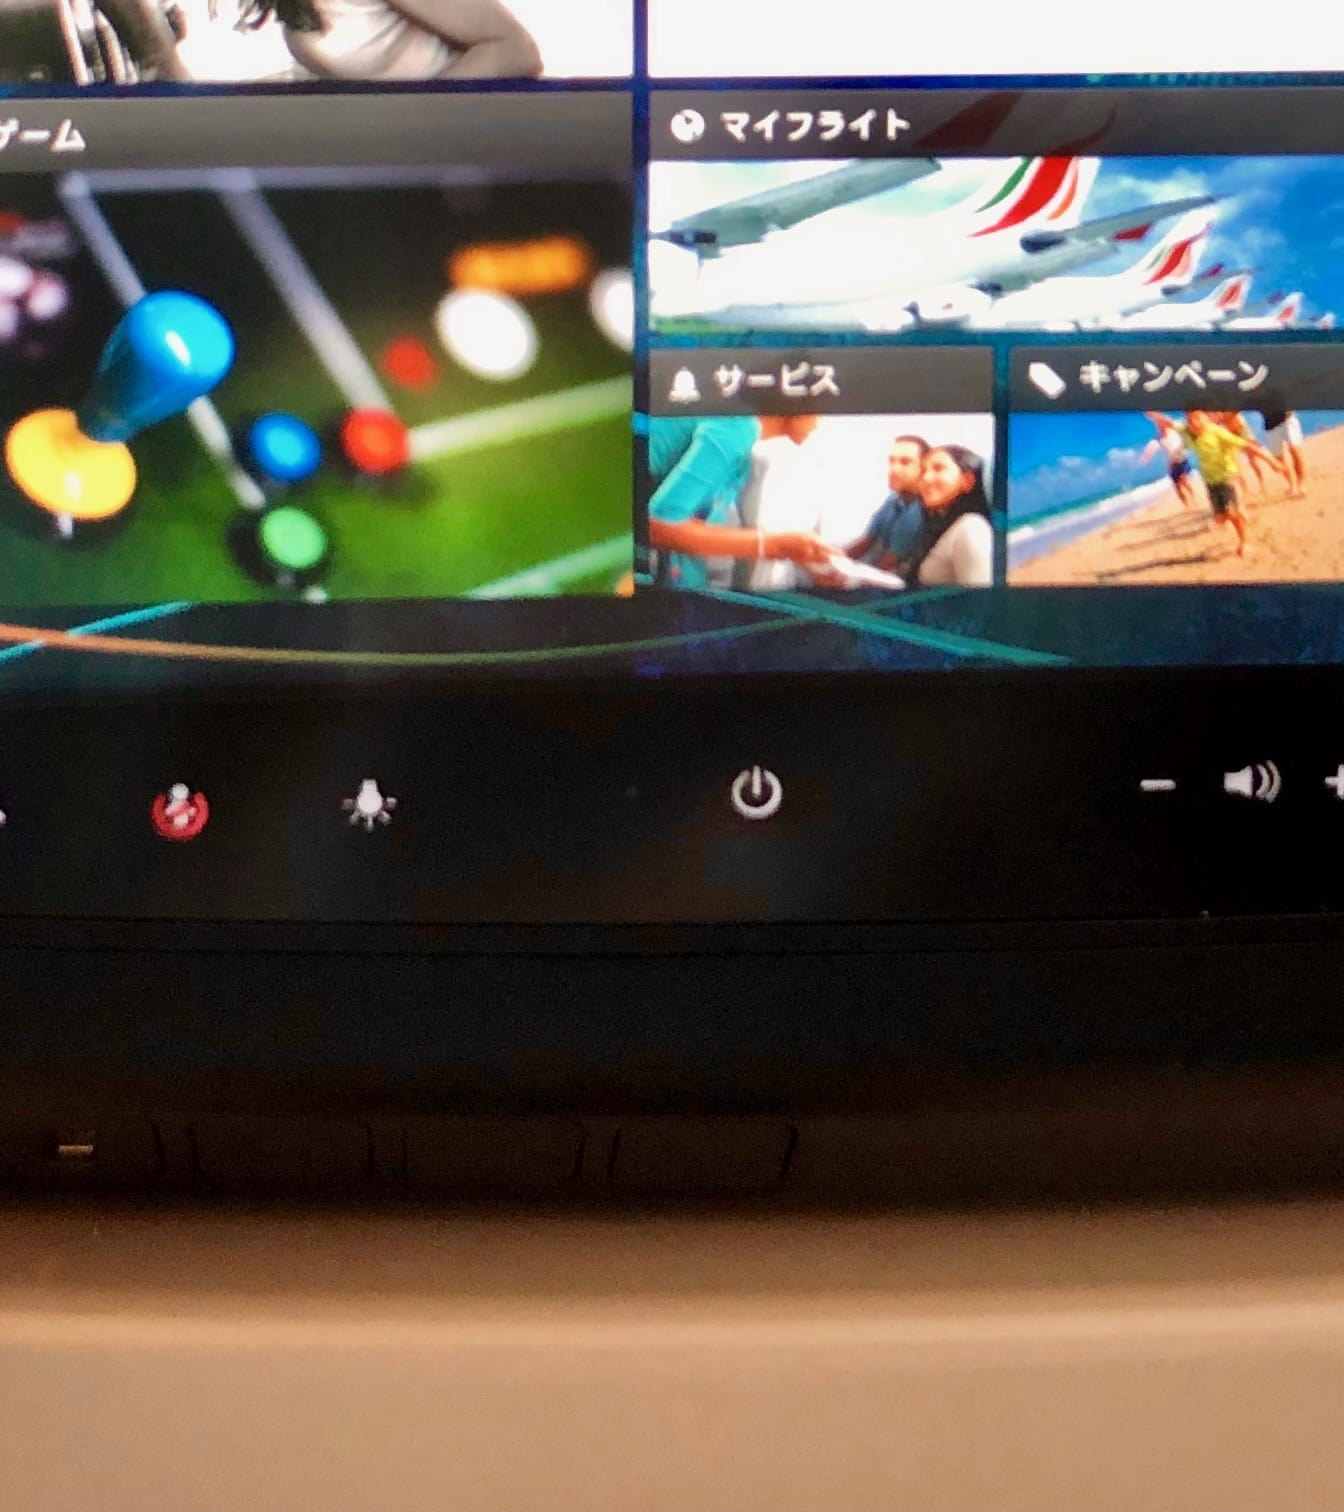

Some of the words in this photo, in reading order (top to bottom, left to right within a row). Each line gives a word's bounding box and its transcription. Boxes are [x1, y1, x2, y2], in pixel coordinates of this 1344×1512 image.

[721, 106, 911, 142] マイフライト
[713, 363, 841, 396] サービス
[1079, 360, 1270, 394] キャンペーン
